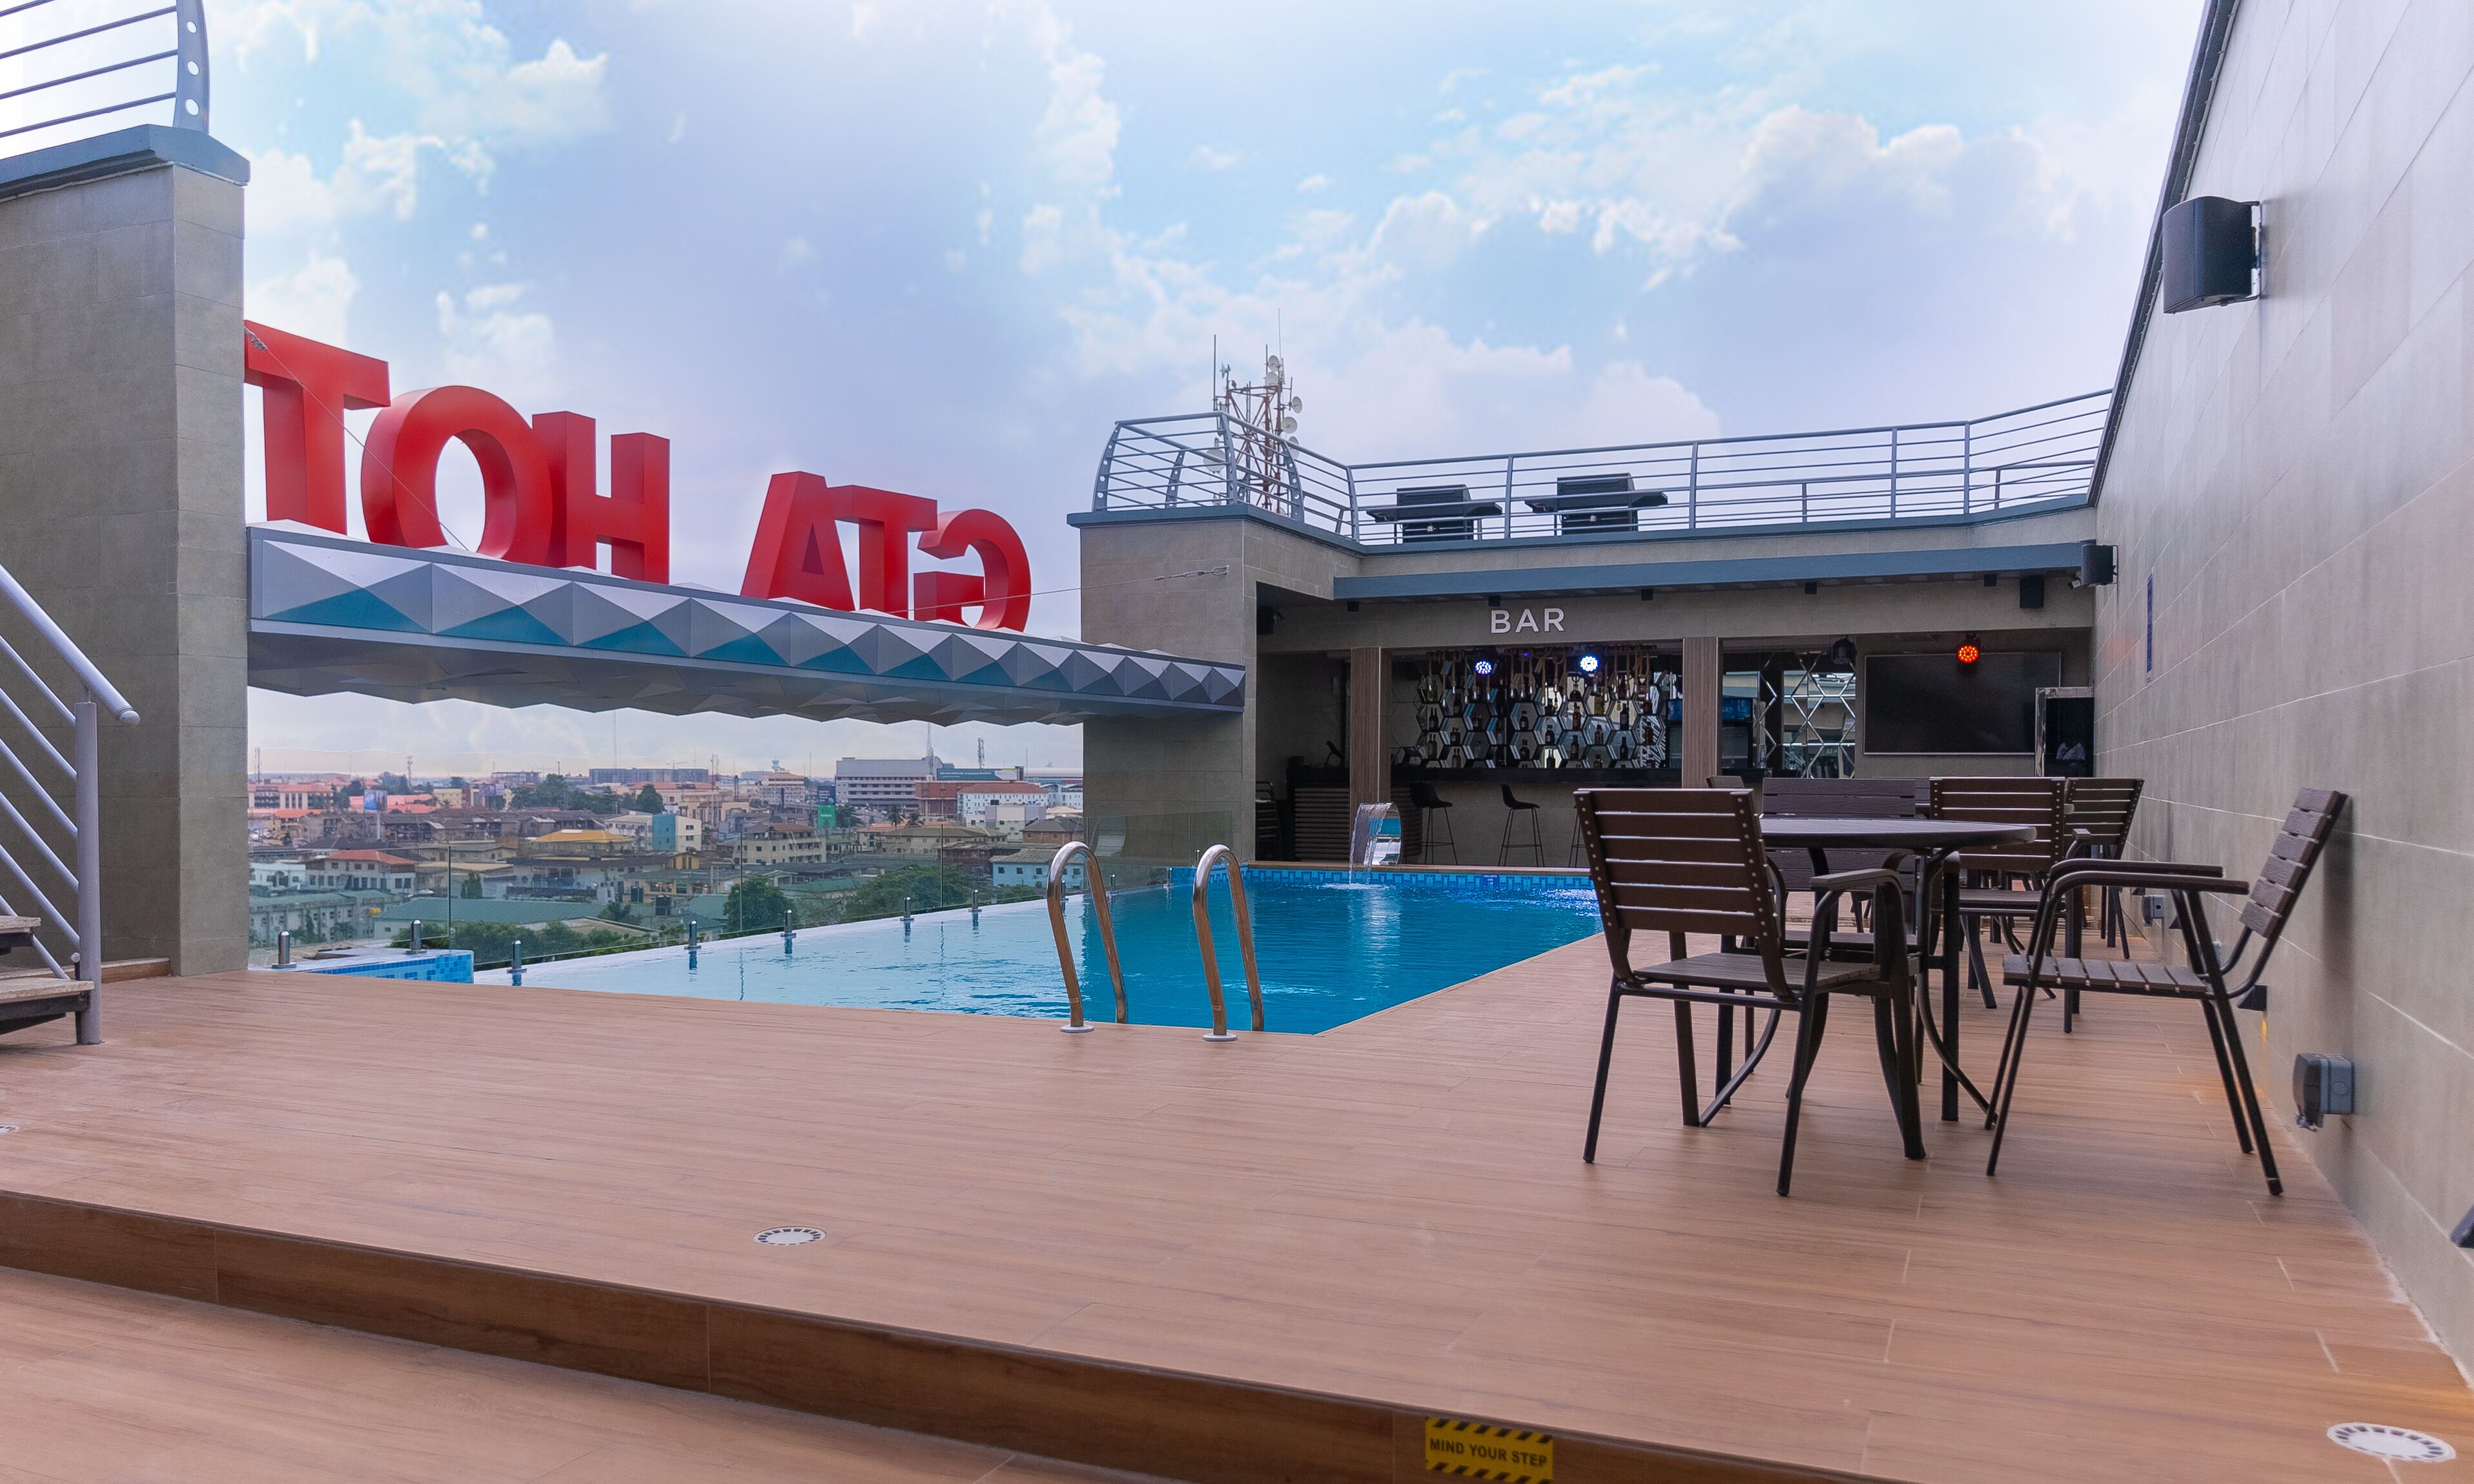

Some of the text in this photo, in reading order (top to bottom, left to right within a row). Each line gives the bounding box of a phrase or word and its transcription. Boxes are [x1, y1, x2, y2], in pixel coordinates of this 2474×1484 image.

[1491, 608, 1565, 633] BAR
[1429, 1438, 1547, 1467] MIND YOUR STEP
